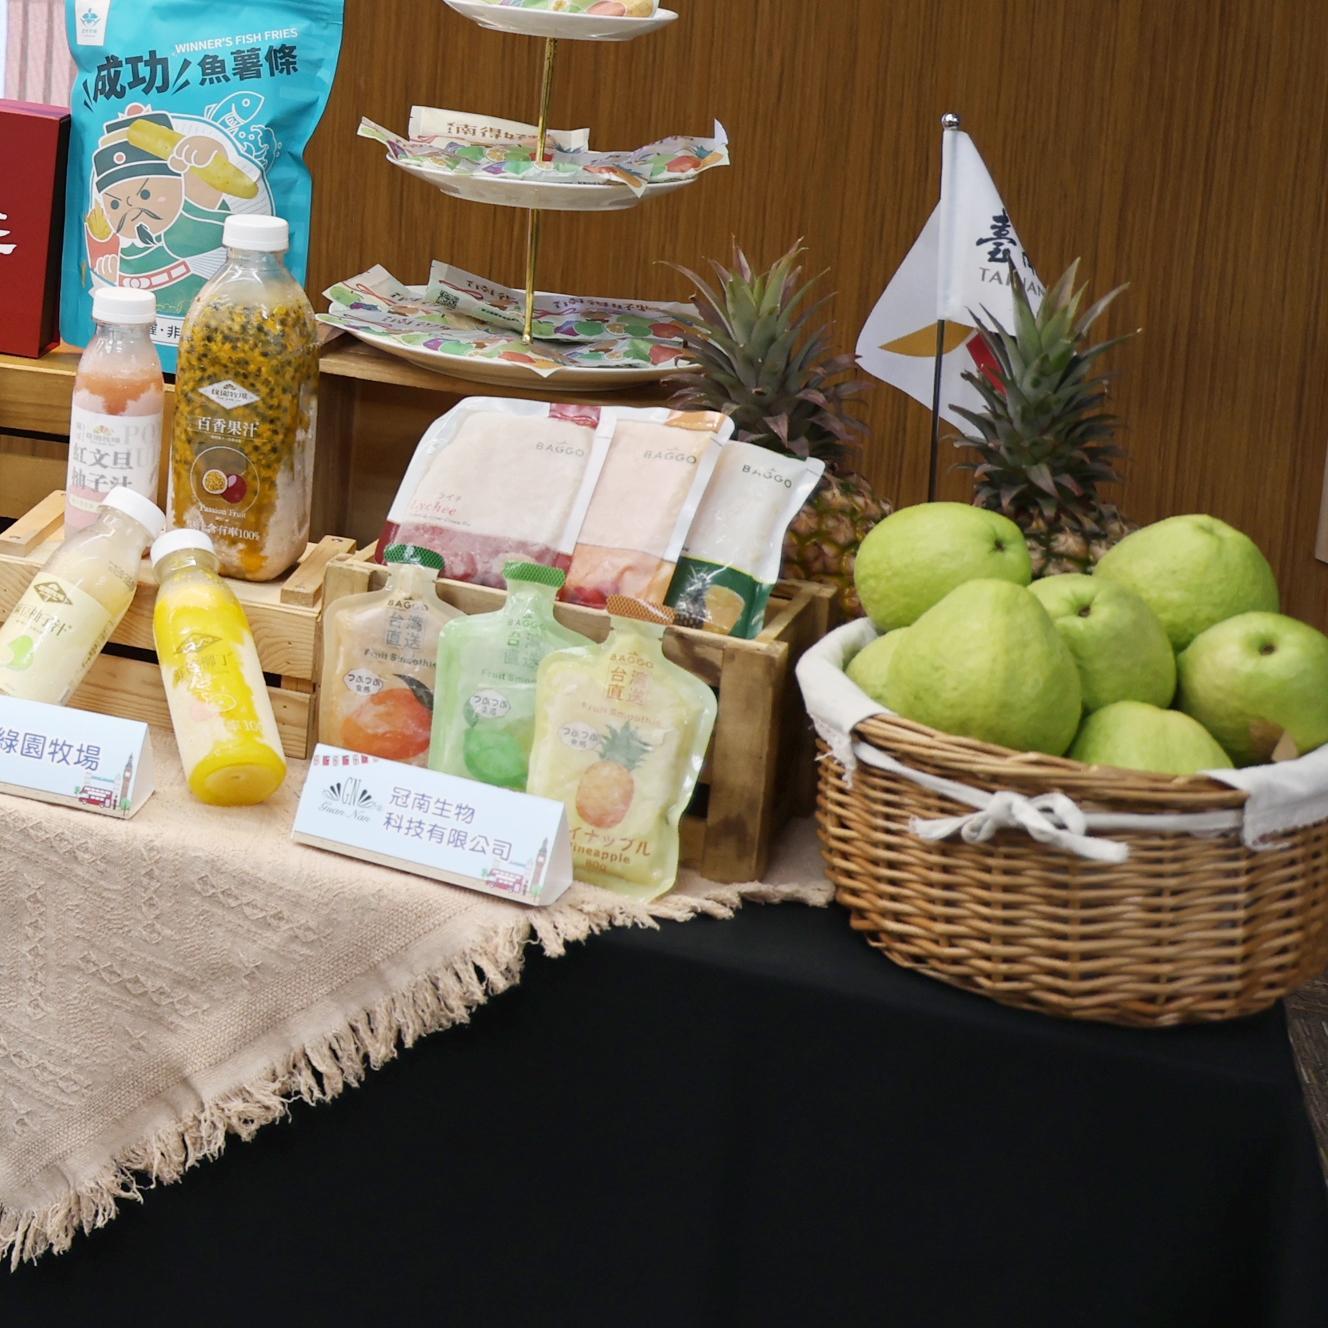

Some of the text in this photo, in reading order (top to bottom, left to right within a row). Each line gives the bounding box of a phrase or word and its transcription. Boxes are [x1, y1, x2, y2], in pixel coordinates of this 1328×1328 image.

[174, 27, 298, 54] WINNER'S FISH FRIES
[93, 43, 299, 103] 成功 魚薯條
[197, 416, 259, 438] 百香果汁
[535, 442, 585, 457] BAGGO
[643, 449, 697, 465] BAGGO
[742, 464, 793, 489] BAGGO
[199, 504, 247, 519] Passion Fruit
[410, 500, 457, 516] Lychee
[364, 648, 388, 660] Fruit
[610, 652, 654, 669] BAGGO
[481, 669, 506, 681] Fruit
[581, 701, 661, 726] Fruit Smoothie
[318, 801, 371, 823] Guan Nan
[388, 786, 476, 825] 冠南生物
[383, 811, 513, 861] 科技有限公司
[569, 826, 651, 857] イナップル
